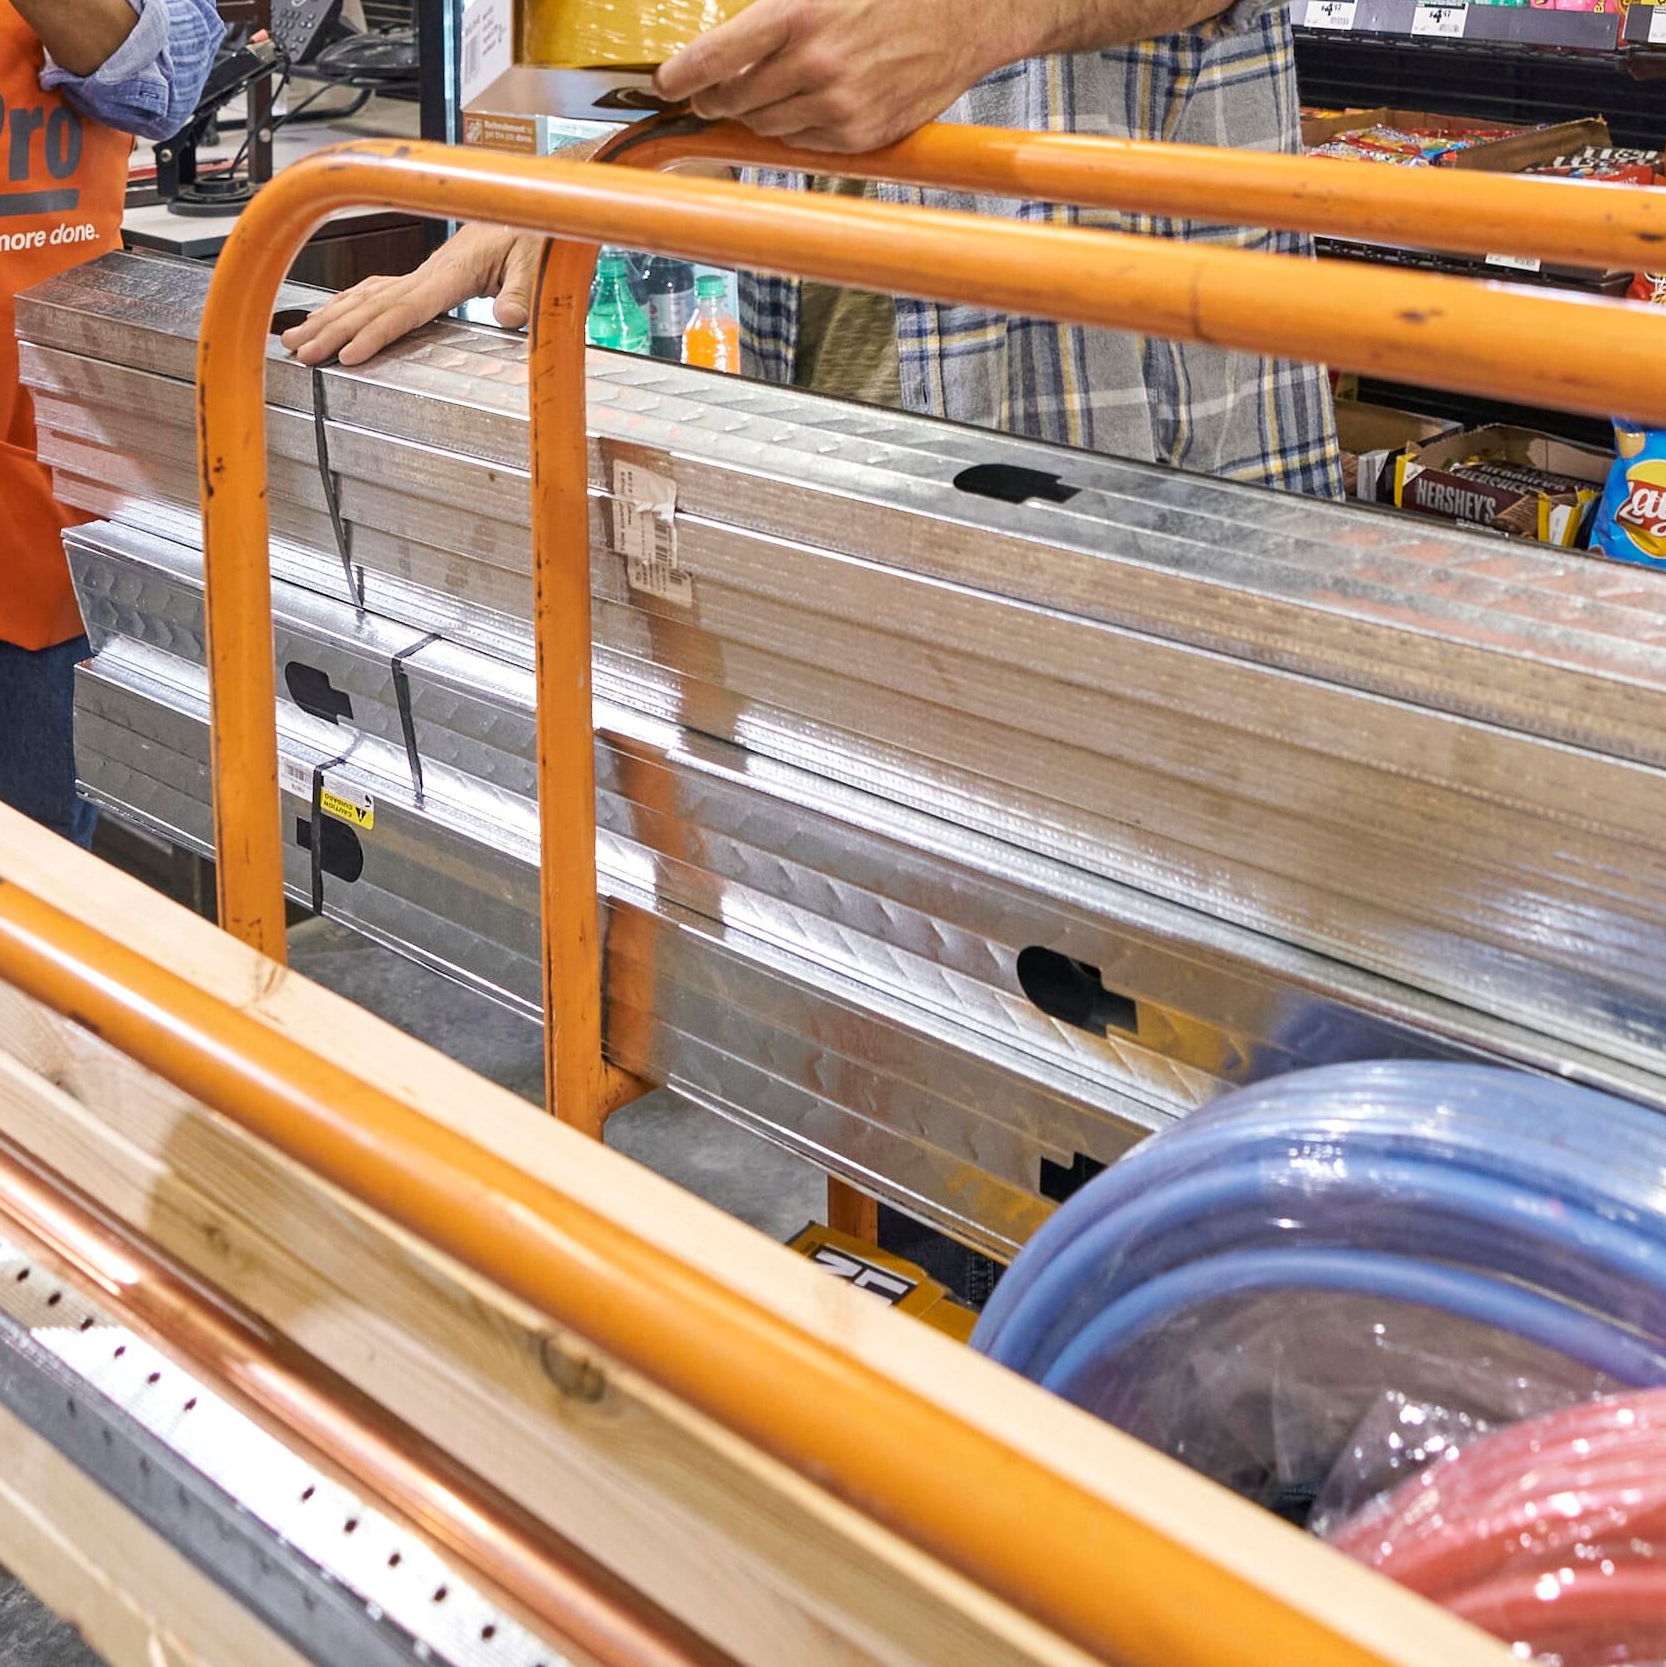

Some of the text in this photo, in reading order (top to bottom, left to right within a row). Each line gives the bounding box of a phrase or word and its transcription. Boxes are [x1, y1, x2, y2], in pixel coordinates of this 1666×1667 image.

[49, 222, 101, 244] done.
[1416, 478, 1497, 525] HERSHEY'S
[323, 800, 352, 818] CAUTION
